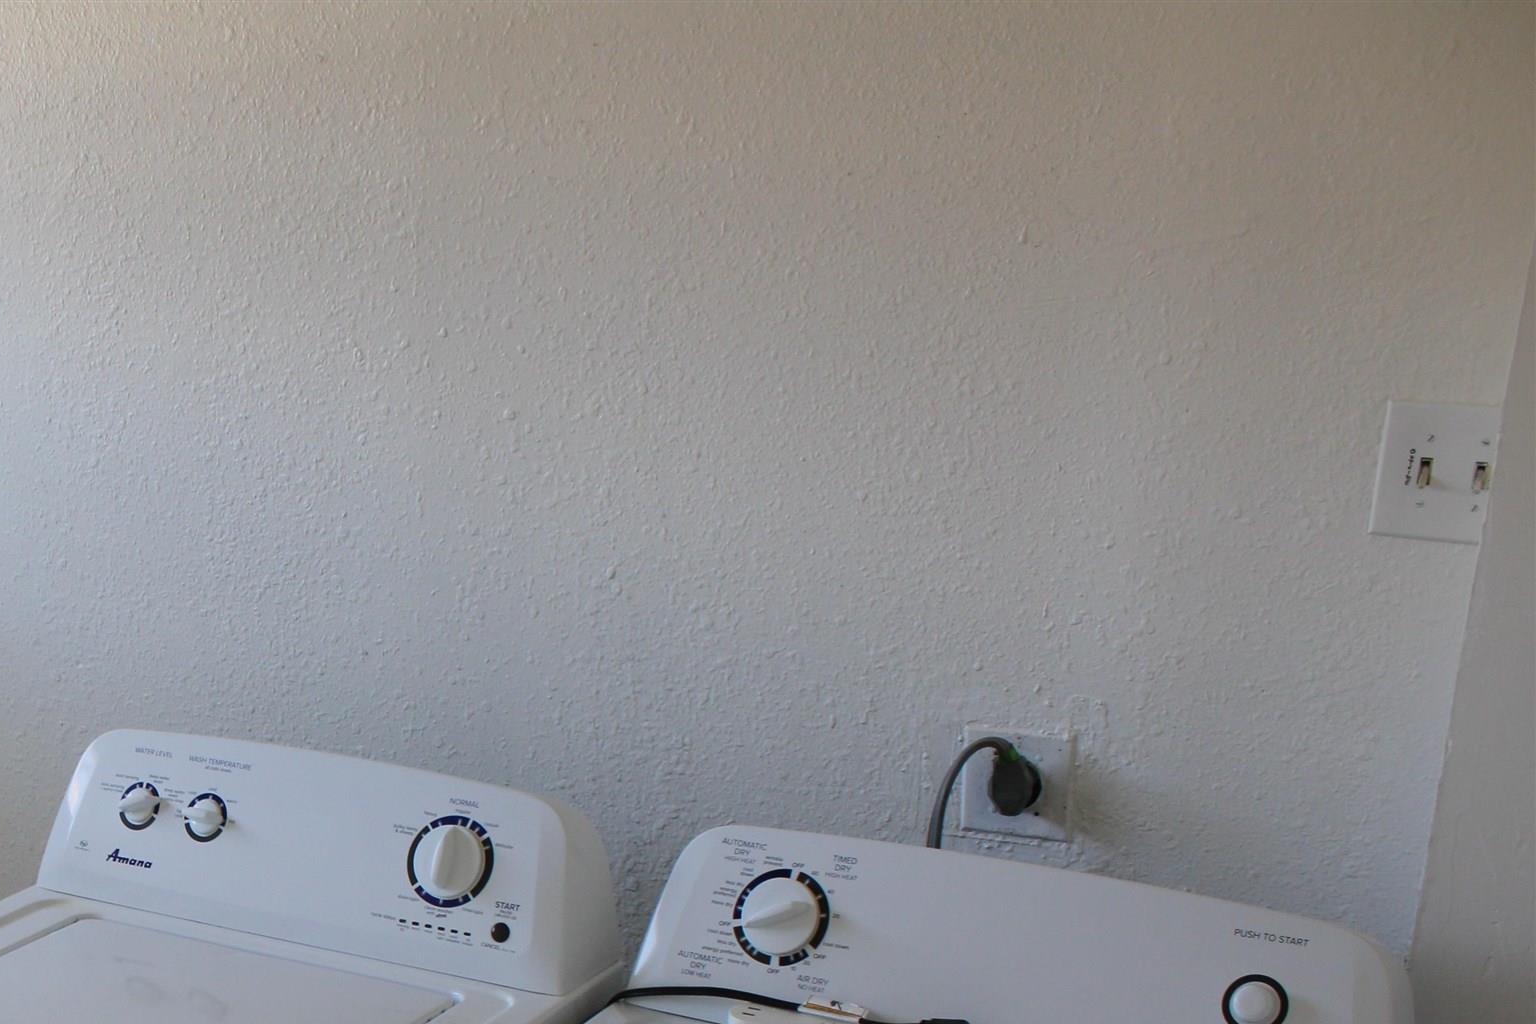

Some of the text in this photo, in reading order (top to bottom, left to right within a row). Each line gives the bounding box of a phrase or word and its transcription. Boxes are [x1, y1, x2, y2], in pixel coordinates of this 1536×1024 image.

[449, 798, 480, 808] NORMAL
[722, 838, 767, 851] AUTOMATIC
[734, 848, 751, 856] DRY
[106, 848, 152, 869] Amana
[833, 854, 858, 865] TIMED
[834, 864, 851, 873] DRY
[495, 901, 520, 911] START
[1234, 928, 1311, 947] PUSH TO START
[678, 950, 723, 965] AUTOMATIC
[689, 961, 706, 969] DRY
[797, 974, 829, 986] AIR DRY
